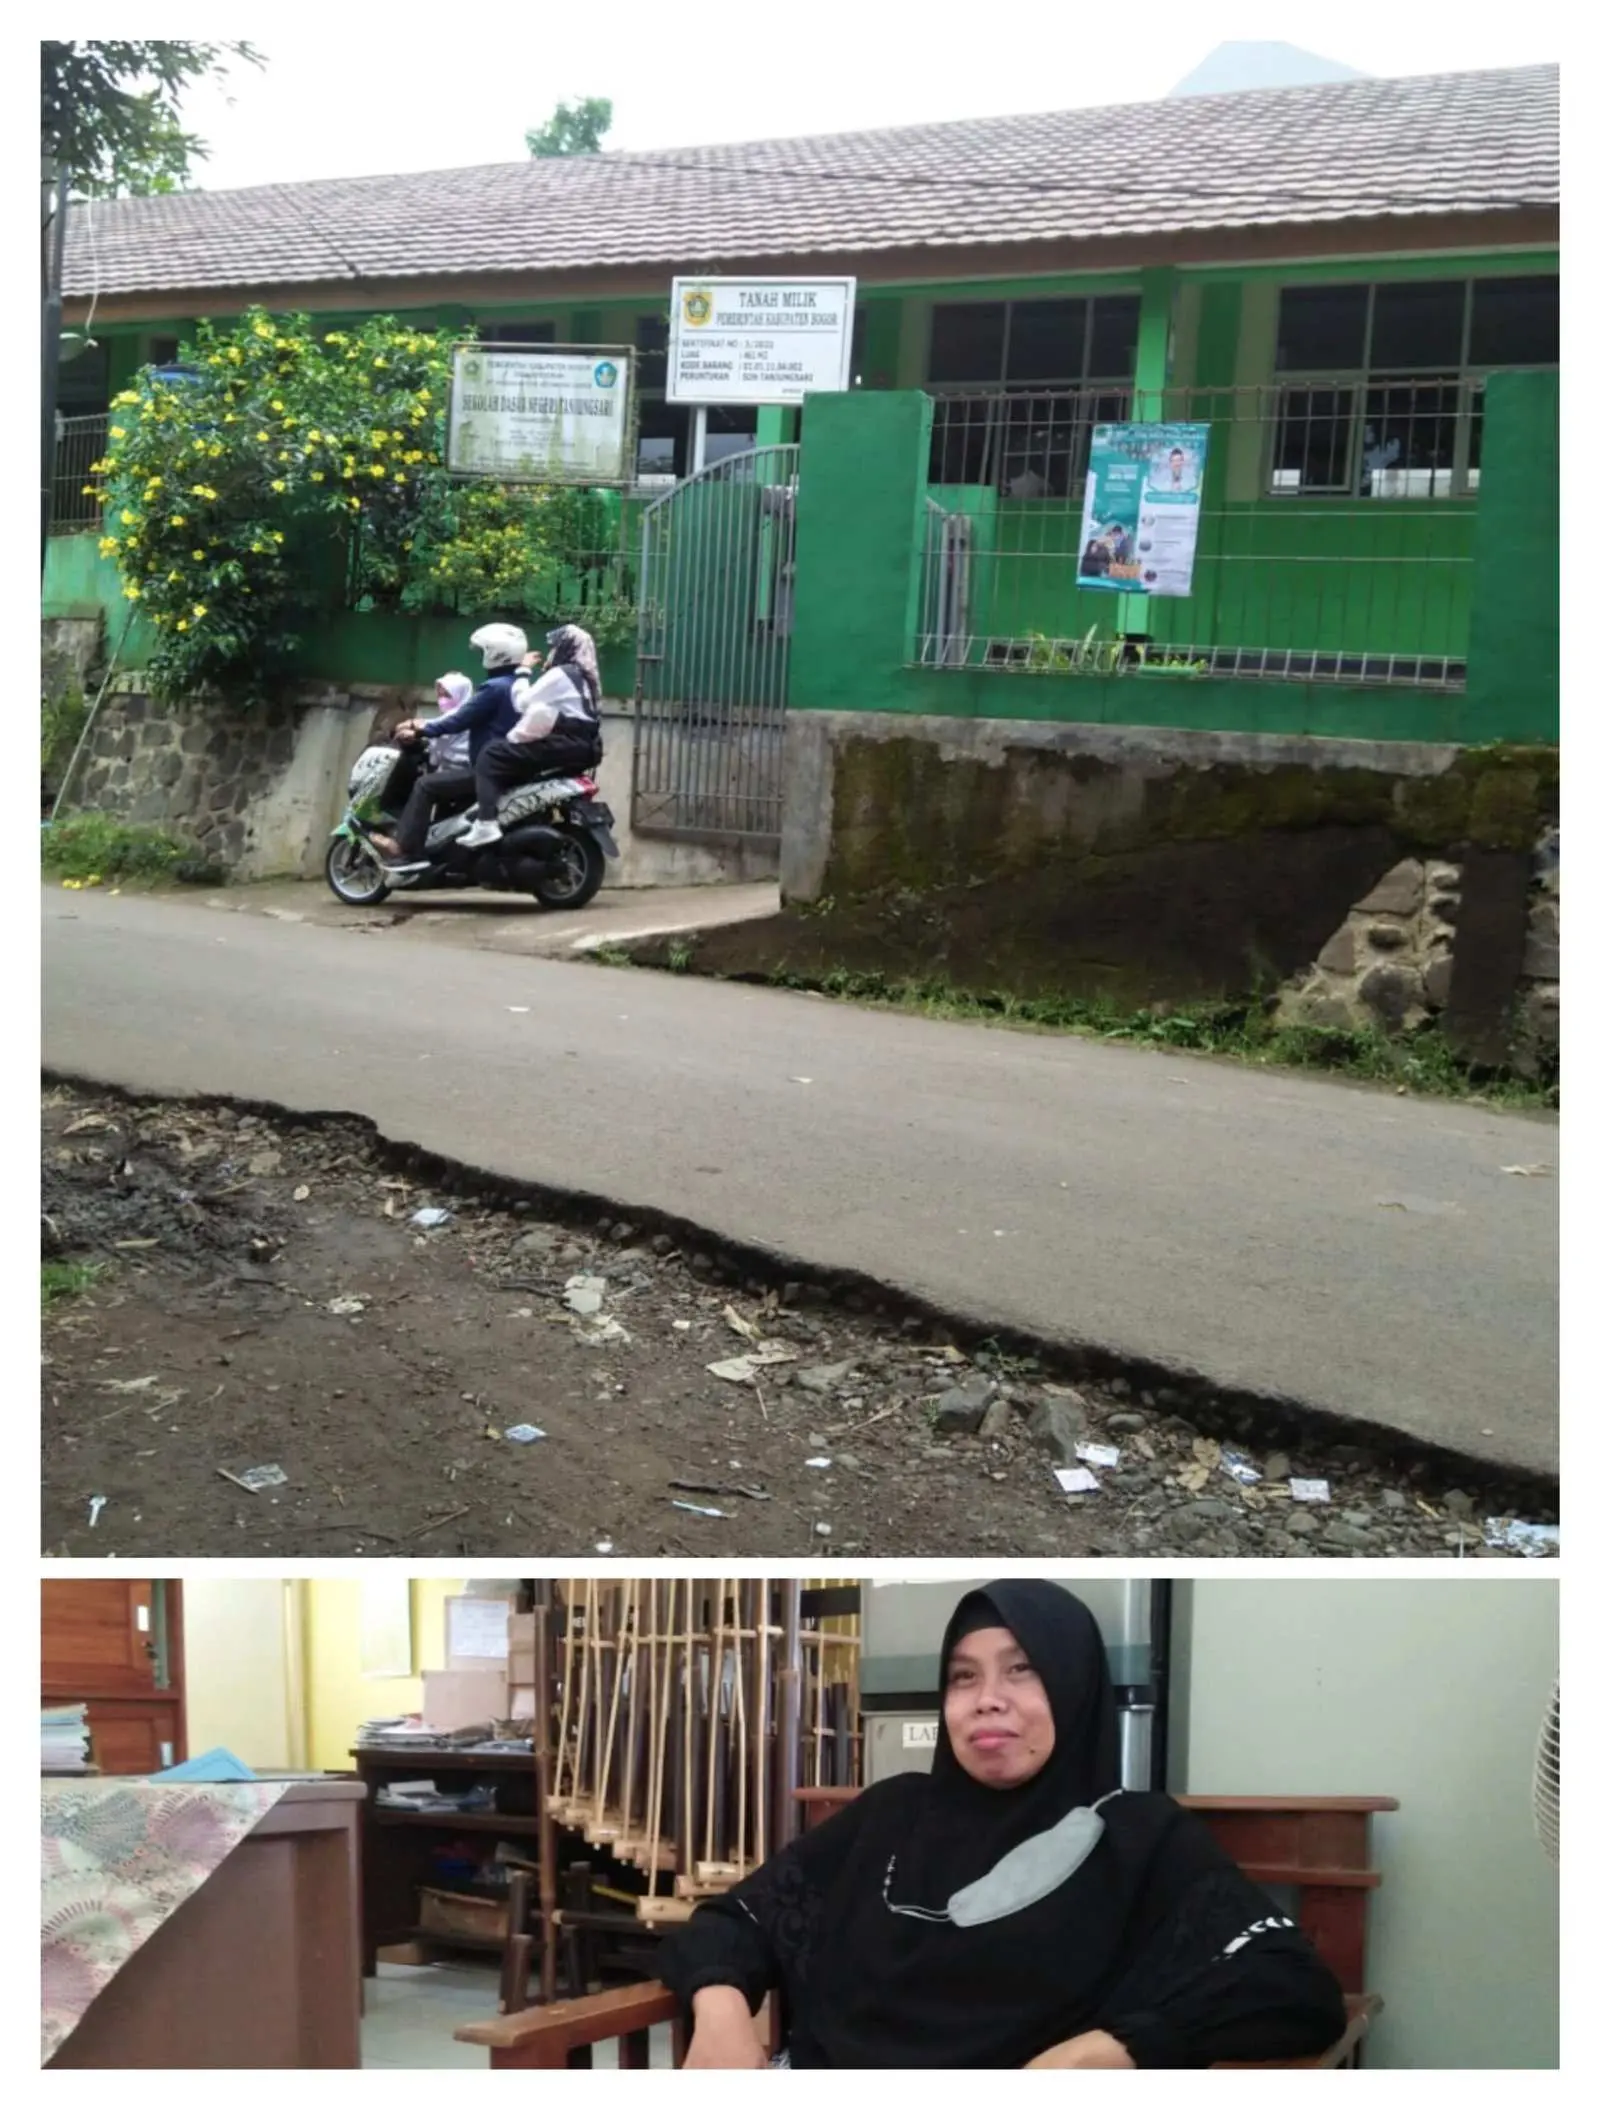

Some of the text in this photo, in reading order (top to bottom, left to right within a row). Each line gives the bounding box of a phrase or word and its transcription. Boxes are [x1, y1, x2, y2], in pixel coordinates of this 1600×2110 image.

[740, 292, 817, 308] TANAH MILIK
[716, 312, 838, 326] PEMERINTAH KABUPATEN BOGOR
[462, 394, 499, 412] SEKOLAH
